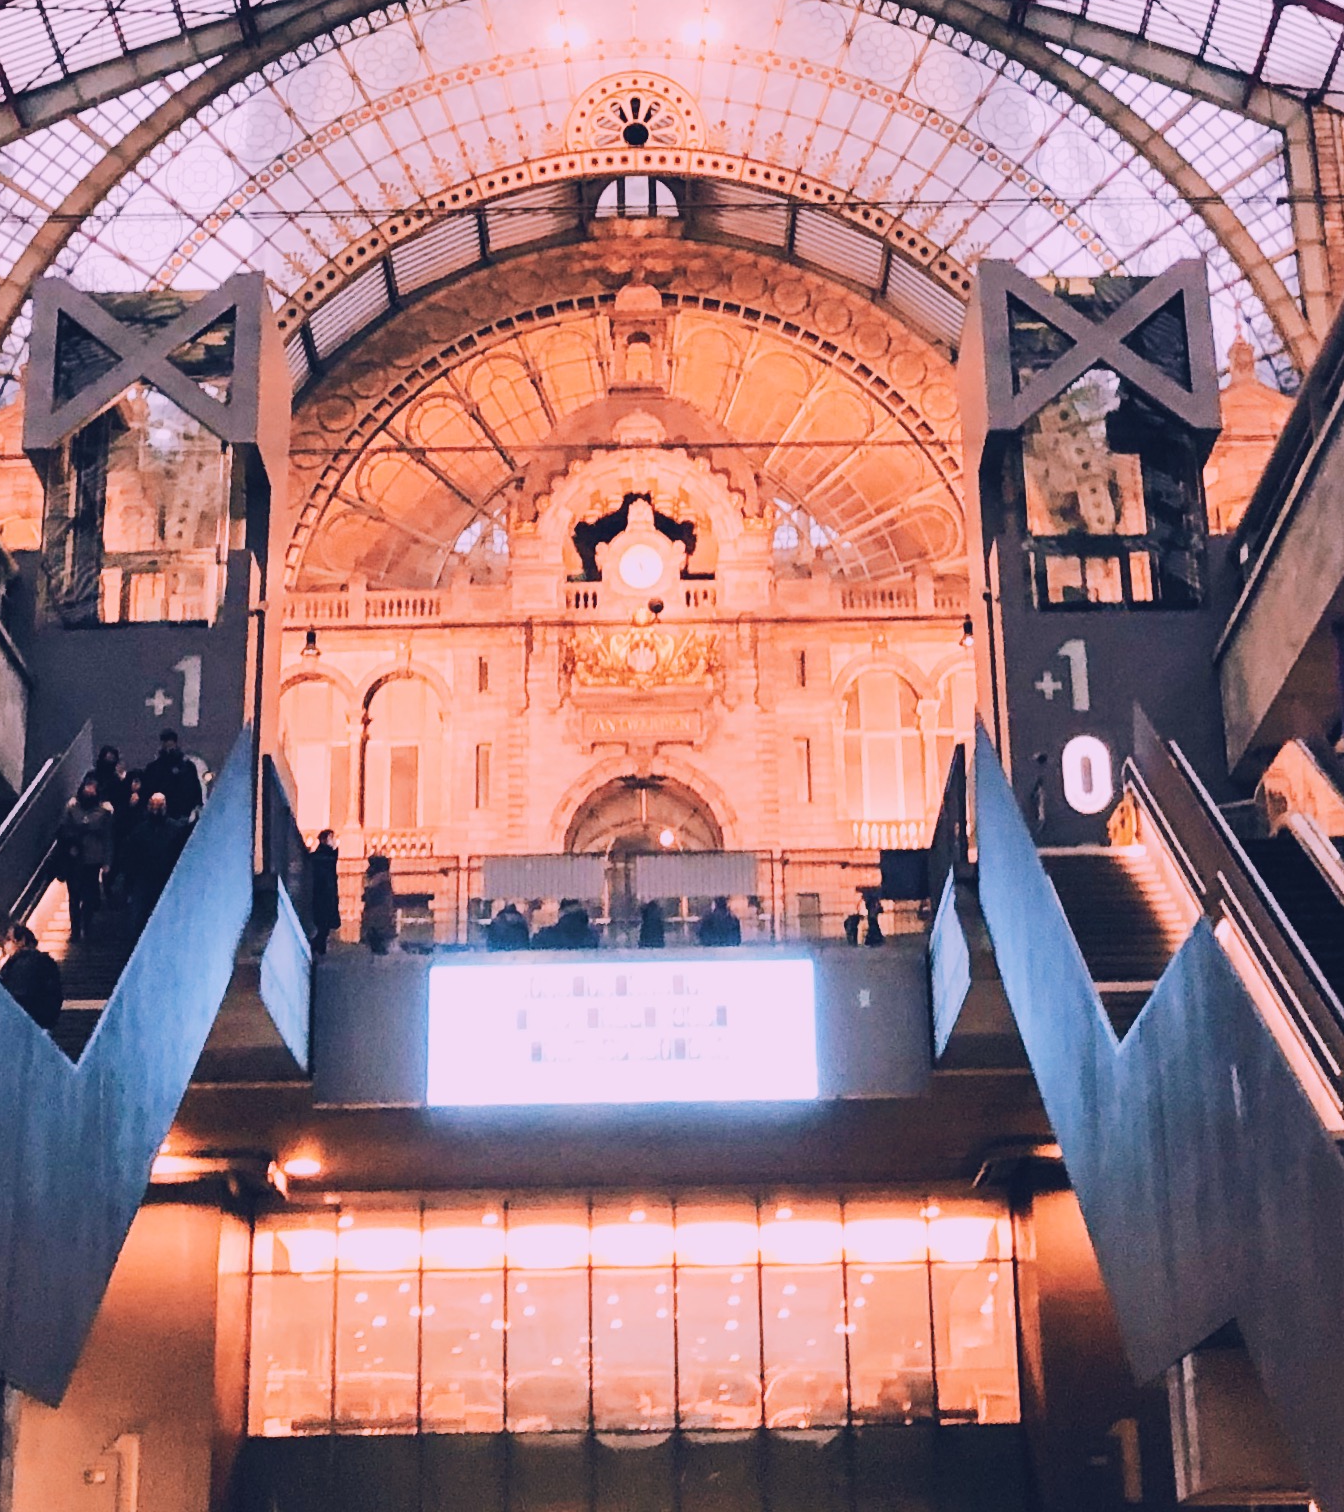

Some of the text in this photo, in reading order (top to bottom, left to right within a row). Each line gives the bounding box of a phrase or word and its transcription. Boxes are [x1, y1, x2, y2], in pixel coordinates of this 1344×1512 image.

[145, 654, 202, 727] +1
[1034, 639, 1090, 711] +1
[1062, 735, 1113, 814] 0
